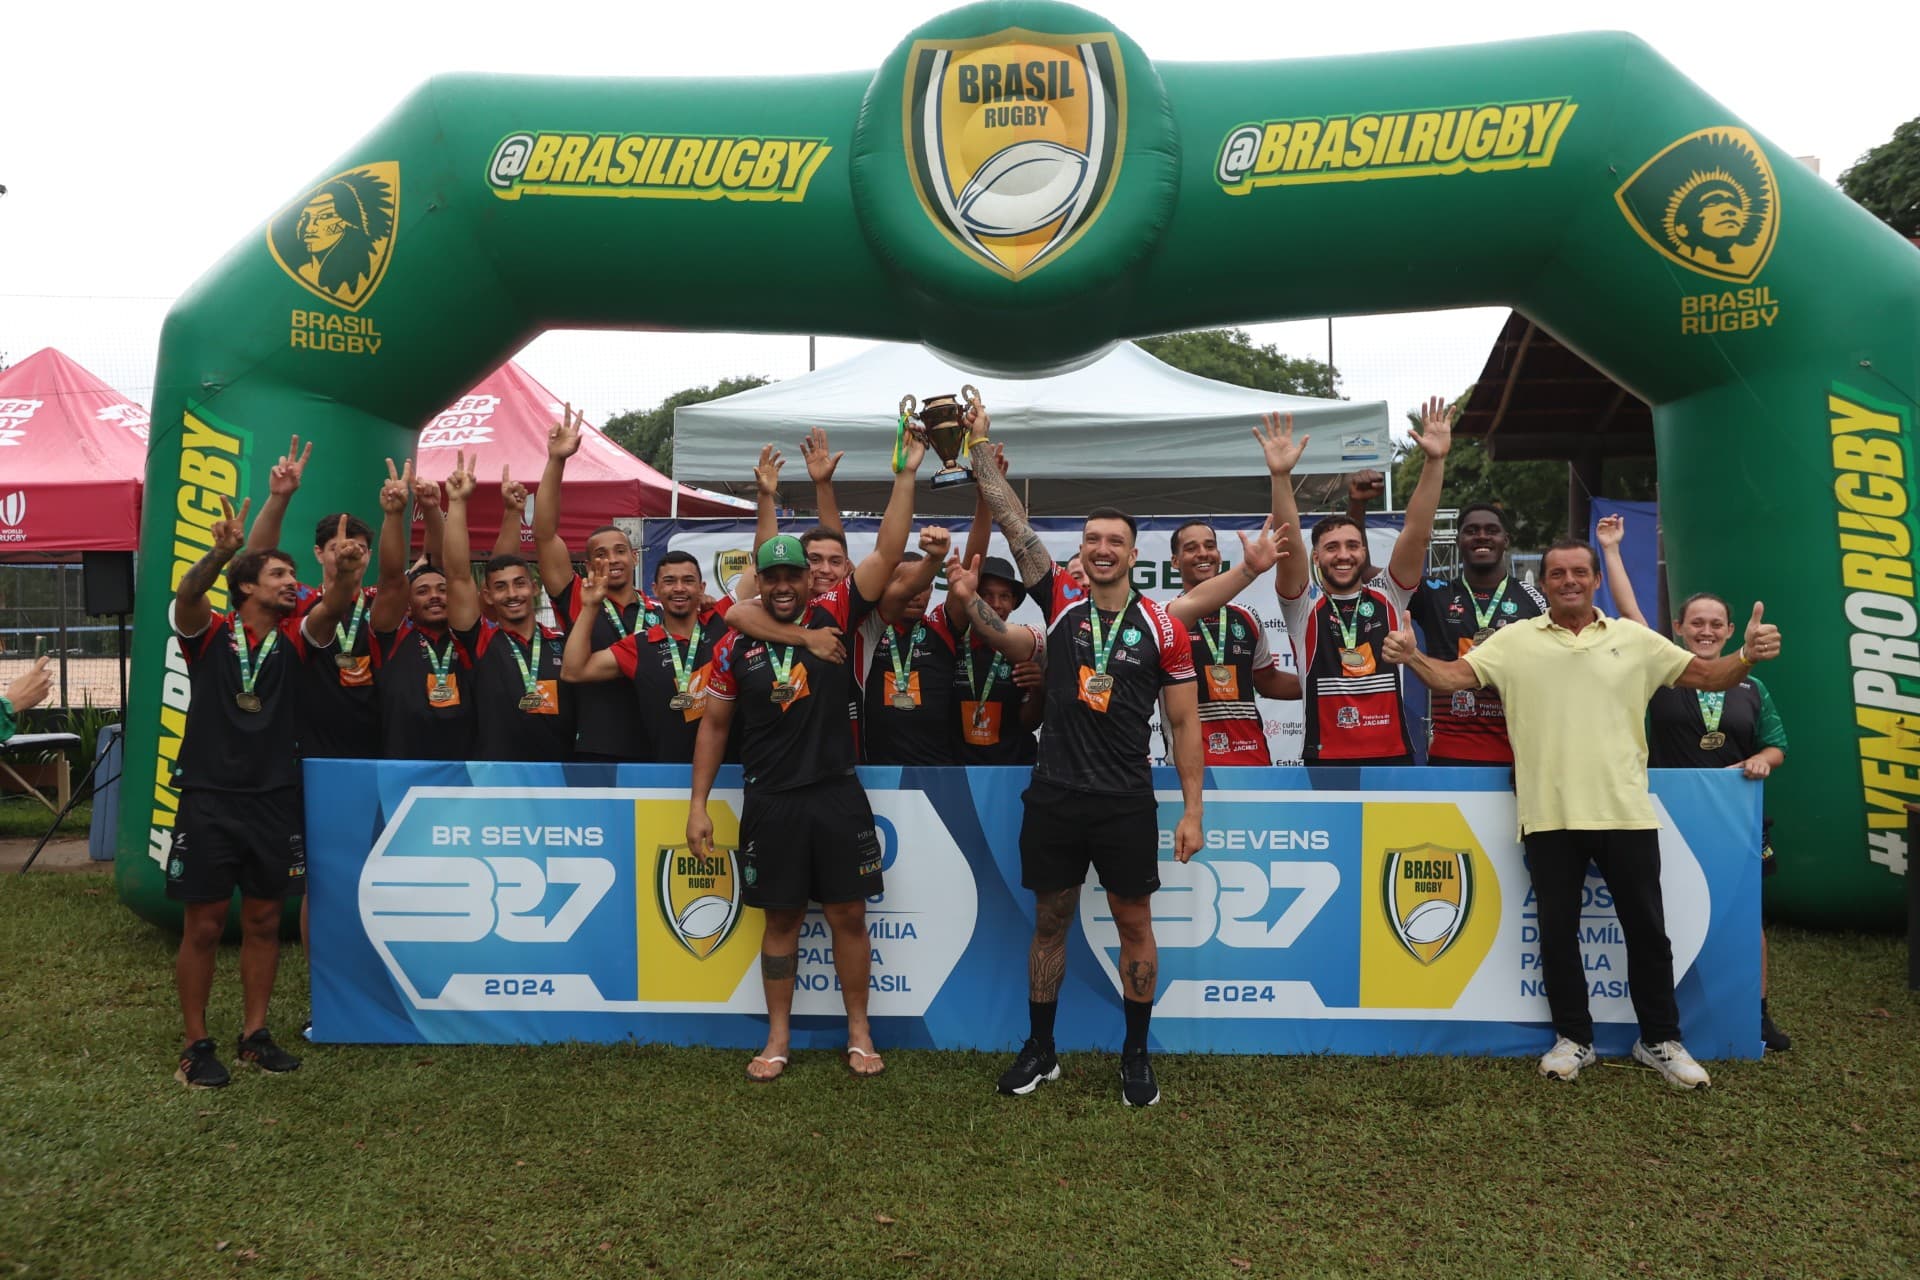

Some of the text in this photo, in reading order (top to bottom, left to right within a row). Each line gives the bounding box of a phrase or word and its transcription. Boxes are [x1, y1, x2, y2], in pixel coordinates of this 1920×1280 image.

[958, 60, 1075, 104] BRASIL
[984, 105, 1049, 128] RUGBY
[1218, 99, 1569, 184] @BRASILRUGBY
[490, 133, 827, 191] @BRASILRUGBY
[1681, 287, 1779, 315] BRASIL
[291, 310, 381, 335] BRASIL
[1681, 307, 1779, 335] RUGBY
[290, 331, 381, 355] RUGBY
[450, 399, 491, 412] EEP
[430, 415, 492, 431] UGBY
[422, 430, 474, 444] EAN
[431, 826, 604, 846] BR SEVENS
[1206, 829, 1330, 850] SEVENS
[677, 856, 727, 877] BRASIL
[1403, 859, 1455, 880] BRASIL
[688, 877, 716, 889] RUGBY
[1414, 881, 1442, 893] RUGBY
[1522, 884, 1615, 909] AOS
[798, 918, 917, 940] DA MÍLIA
[796, 948, 884, 966] PADA
[484, 979, 555, 996] 2024
[795, 974, 912, 993] NO ASIL
[1203, 985, 1276, 1002] 2024
